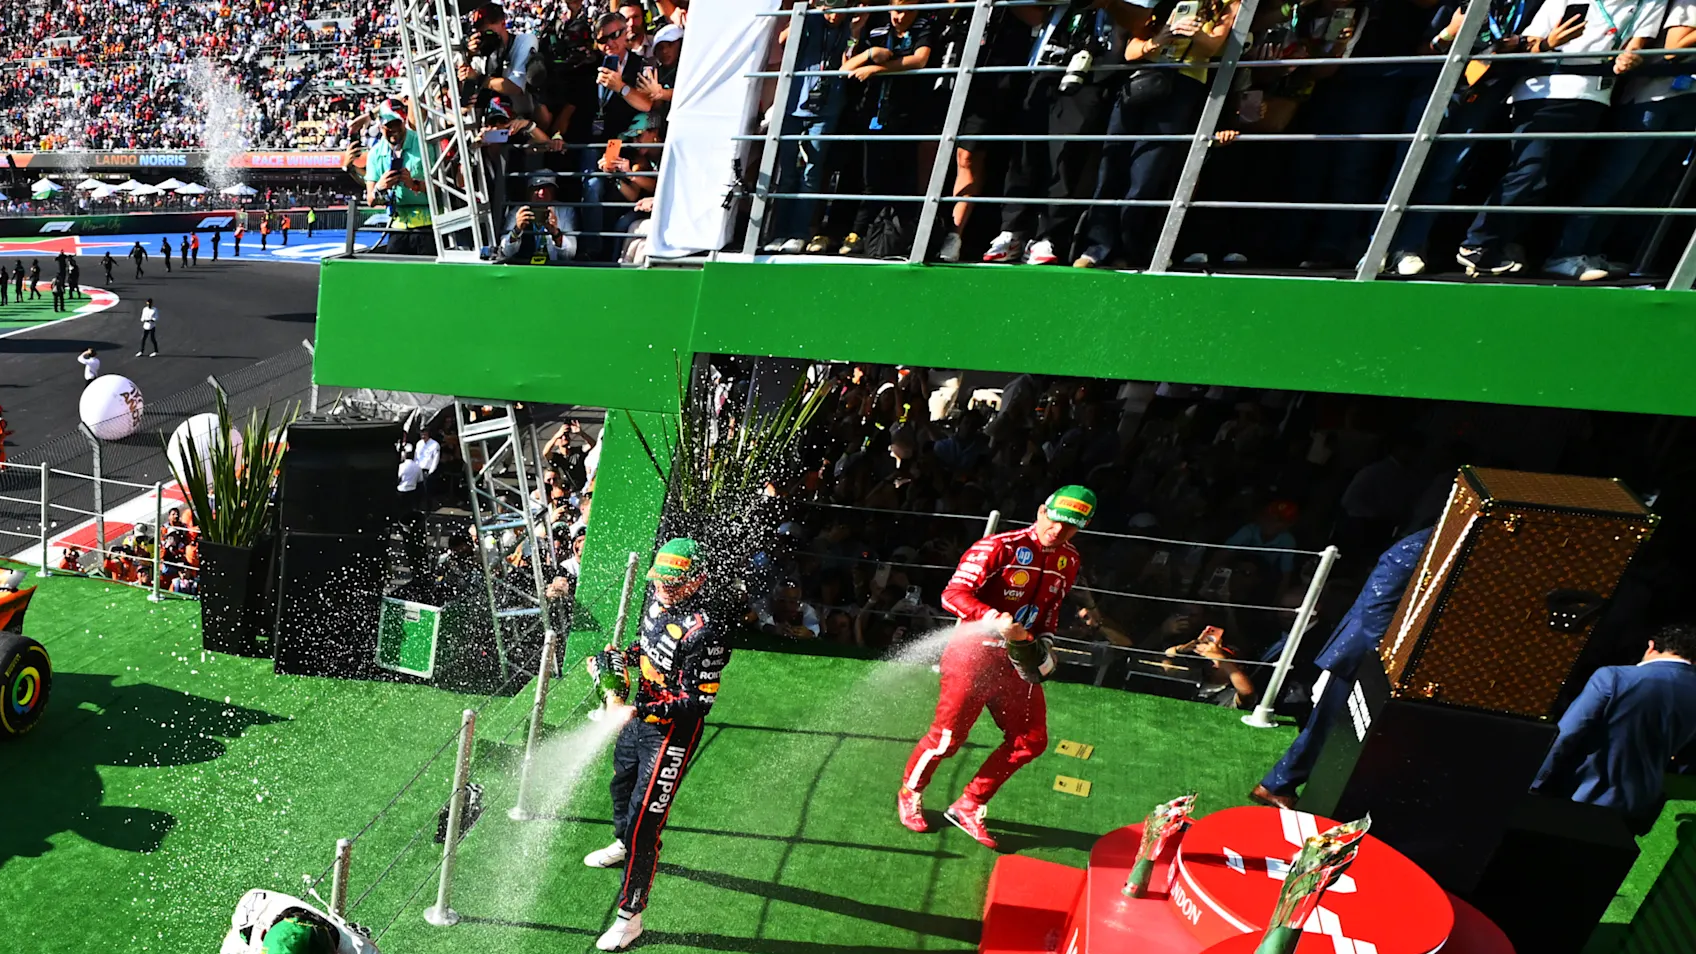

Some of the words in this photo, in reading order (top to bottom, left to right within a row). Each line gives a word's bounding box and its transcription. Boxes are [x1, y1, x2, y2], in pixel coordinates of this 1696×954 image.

[96, 154, 137, 165] LANDO
[139, 155, 186, 166] NORRIS
[252, 155, 285, 166] RACE
[287, 154, 341, 165] WINNER
[1004, 589, 1025, 598] VGW
[707, 646, 725, 656] VISA
[659, 746, 687, 780] Bull
[649, 779, 674, 815] Red
